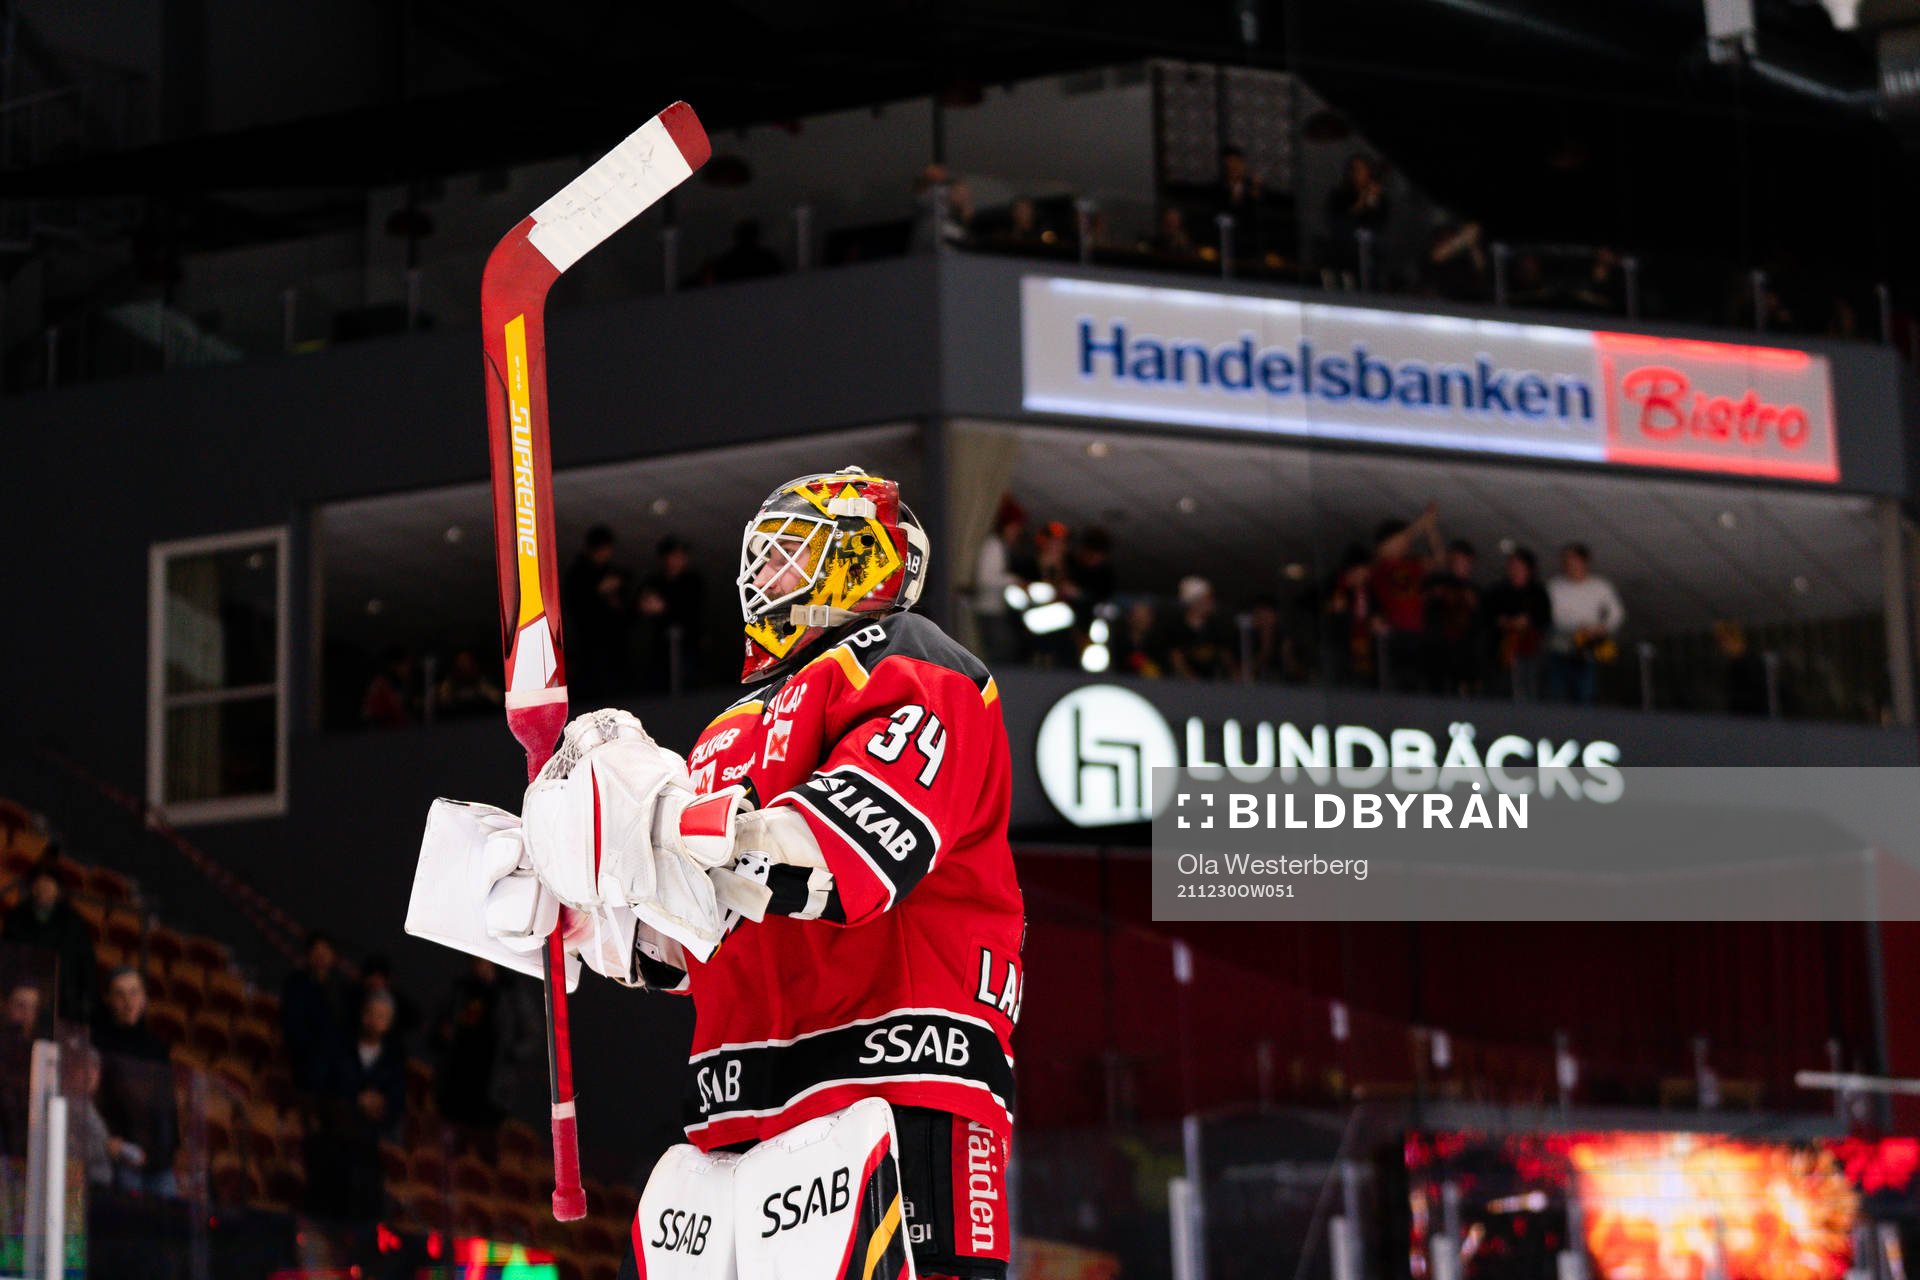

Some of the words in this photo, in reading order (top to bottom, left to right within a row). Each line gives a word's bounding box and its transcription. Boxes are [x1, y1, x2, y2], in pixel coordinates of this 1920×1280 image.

[1078, 319, 1594, 424] Handelsbanken
[1624, 366, 1809, 449] Bistro
[866, 704, 948, 790] 34
[1187, 718, 1624, 803] LUNDBÄCKS
[828, 786, 917, 862] LKAB
[858, 1024, 969, 1064] SSAB
[651, 1208, 712, 1256] SSAB
[761, 1166, 850, 1238] SSAB
